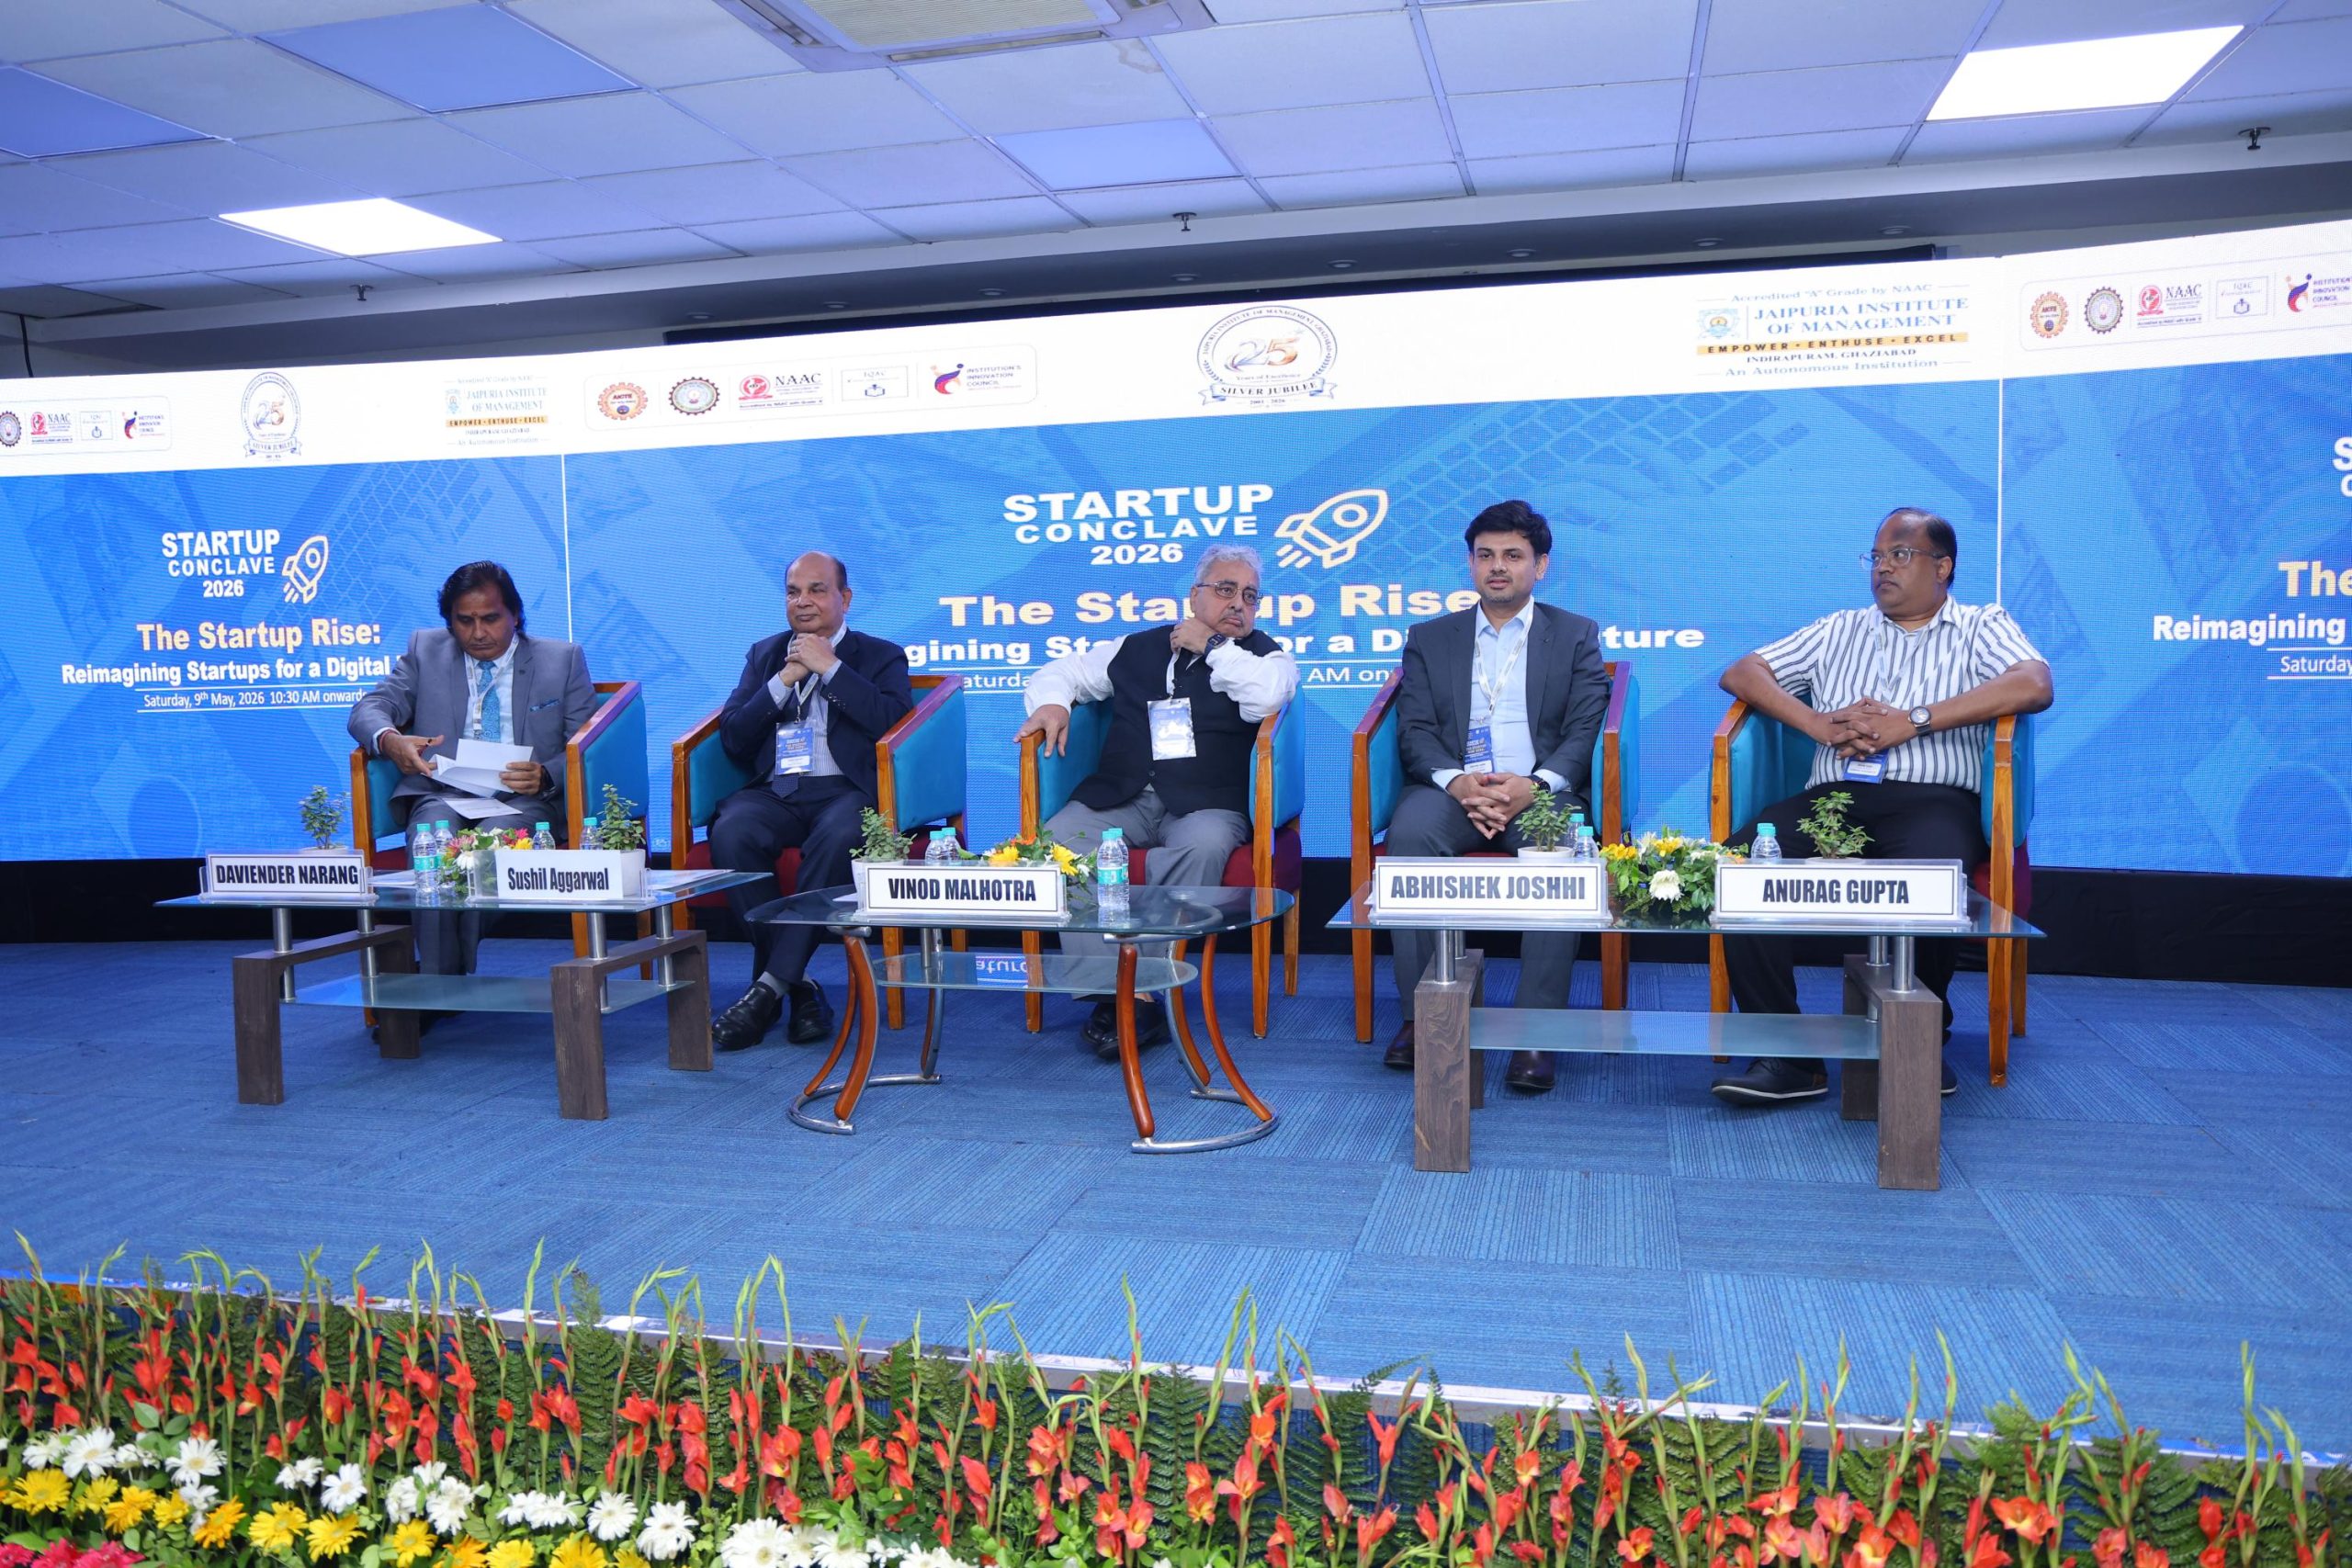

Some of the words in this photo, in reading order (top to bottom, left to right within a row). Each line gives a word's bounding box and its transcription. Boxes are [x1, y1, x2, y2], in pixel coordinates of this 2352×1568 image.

[1731, 291, 1800, 302] Accredited
[1826, 287, 1867, 297] Grade
[1872, 287, 1886, 296] by
[1893, 284, 1932, 293] NAAC
[2166, 284, 2201, 299] NAAC
[1755, 303, 1849, 321] JAIPURIA
[1858, 298, 1969, 315] INSTITUTE
[1768, 322, 1792, 335] OF
[1801, 315, 1956, 333] MANAGEMENT
[1225, 337, 1300, 371] 25
[1708, 343, 1789, 354] EMPOWER
[1808, 338, 1883, 349] ENTHUSE
[1904, 334, 1957, 344] EXCEL
[1841, 348, 1917, 359] GHAZIABAD
[1725, 367, 1747, 377] An
[1753, 363, 1849, 376] Autonomous
[1855, 359, 1938, 370] Institution
[775, 373, 821, 386] NAAC
[1221, 386, 1264, 396] SILVER
[1268, 380, 1317, 396] JUBILEE
[472, 403, 483, 412] OF
[485, 400, 543, 412] MANAGEMENT
[48, 413, 71, 424] NAAC
[1003, 484, 1273, 523] STARTUP
[1014, 516, 1258, 545] CONCLAVE
[162, 529, 280, 558] STARTUP
[1091, 543, 1183, 565] 2026
[168, 557, 276, 577] CONCLAVE
[202, 579, 244, 598] 2026
[939, 595, 1055, 626] The
[136, 624, 190, 650] The
[198, 621, 302, 654] Startup
[311, 618, 381, 647] Rise:
[2153, 614, 2346, 647] Reimagining
[1273, 636, 1314, 654] or
[1327, 634, 1355, 653] a
[62, 661, 182, 688] Reimagining
[187, 659, 271, 684] Startups
[276, 658, 303, 679] for
[309, 662, 321, 678] a
[327, 656, 390, 682] Digital
[1307, 668, 1351, 682] AM
[143, 694, 192, 710] Saturday,
[194, 691, 209, 707] 9th
[210, 692, 236, 709] May,
[239, 691, 265, 705] 2026
[270, 691, 300, 705] 10:30
[301, 690, 321, 704] AM
[216, 865, 295, 885] DAVIENDER
[298, 865, 359, 885] NARANG
[507, 867, 548, 891] Sushil
[549, 867, 610, 893] Aggarwal
[888, 878, 941, 900] VINOD
[944, 878, 1036, 901] MALHOTRA
[1391, 875, 1501, 899] ABHISHEK
[1506, 876, 1586, 900] JOSHHI
[1762, 878, 1841, 904] ANURAG
[1847, 879, 1910, 904] GUPTA
